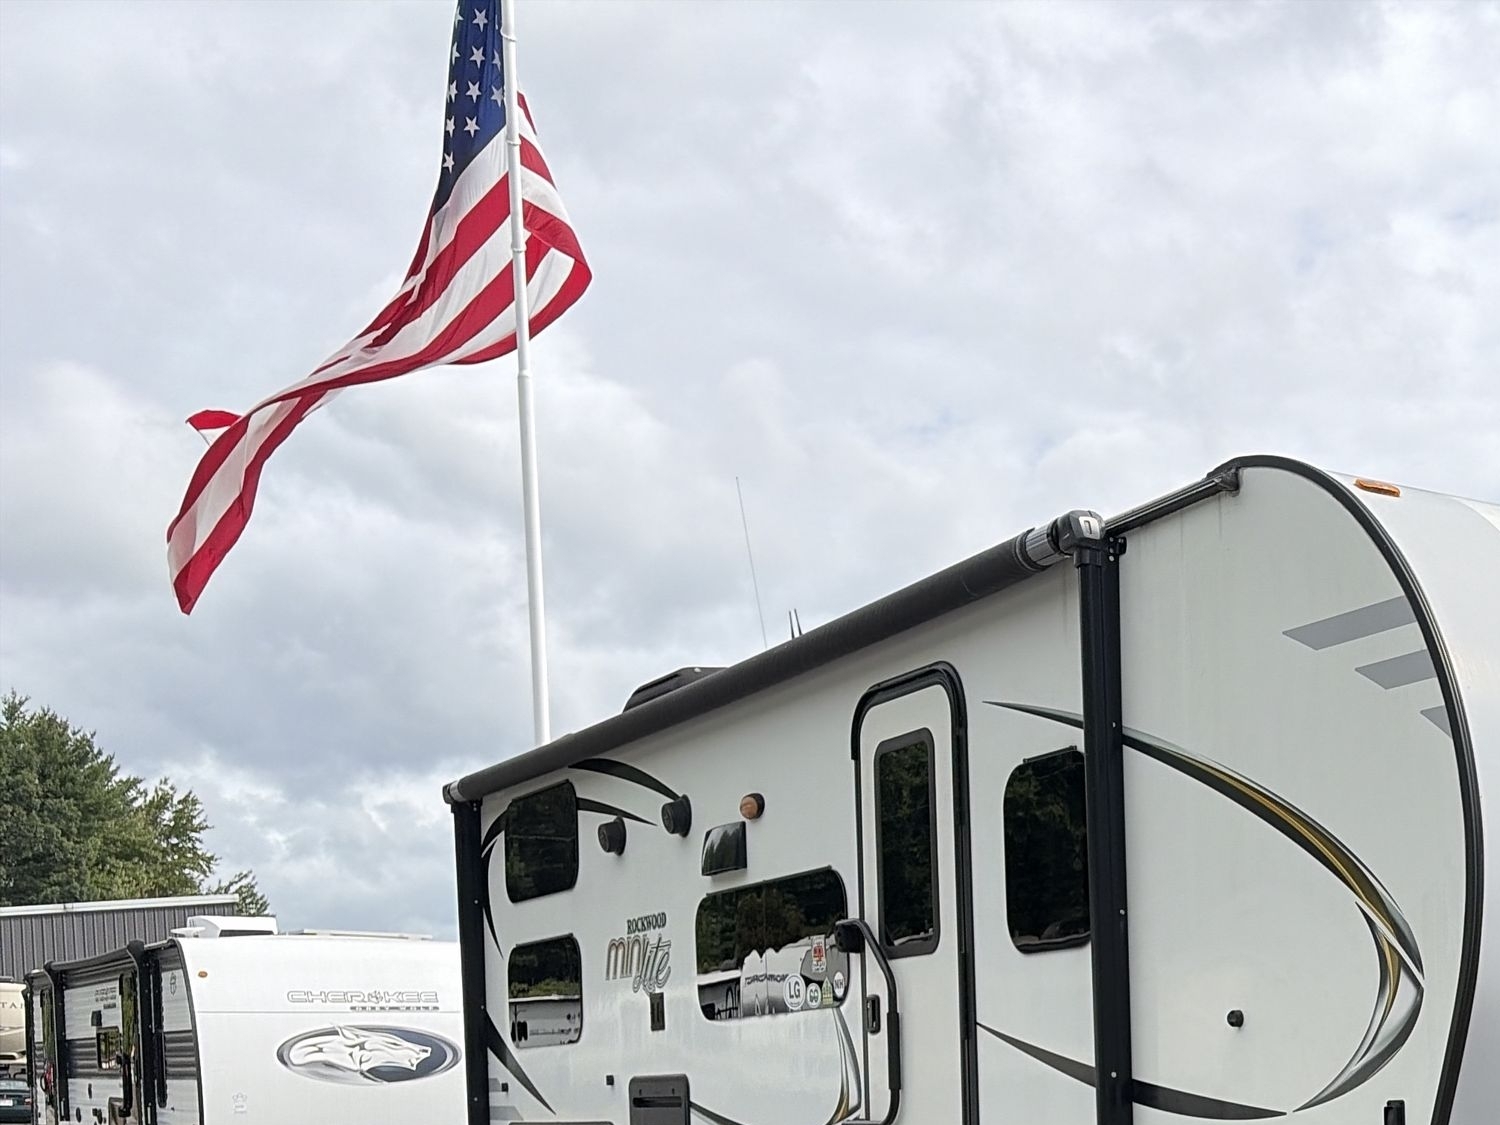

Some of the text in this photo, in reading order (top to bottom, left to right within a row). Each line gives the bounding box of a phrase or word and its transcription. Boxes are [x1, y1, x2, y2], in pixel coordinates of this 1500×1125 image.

[626, 912, 667, 935] ROCKWOOD
[287, 989, 440, 1004] CHEROKEE
[788, 980, 801, 999] LG
